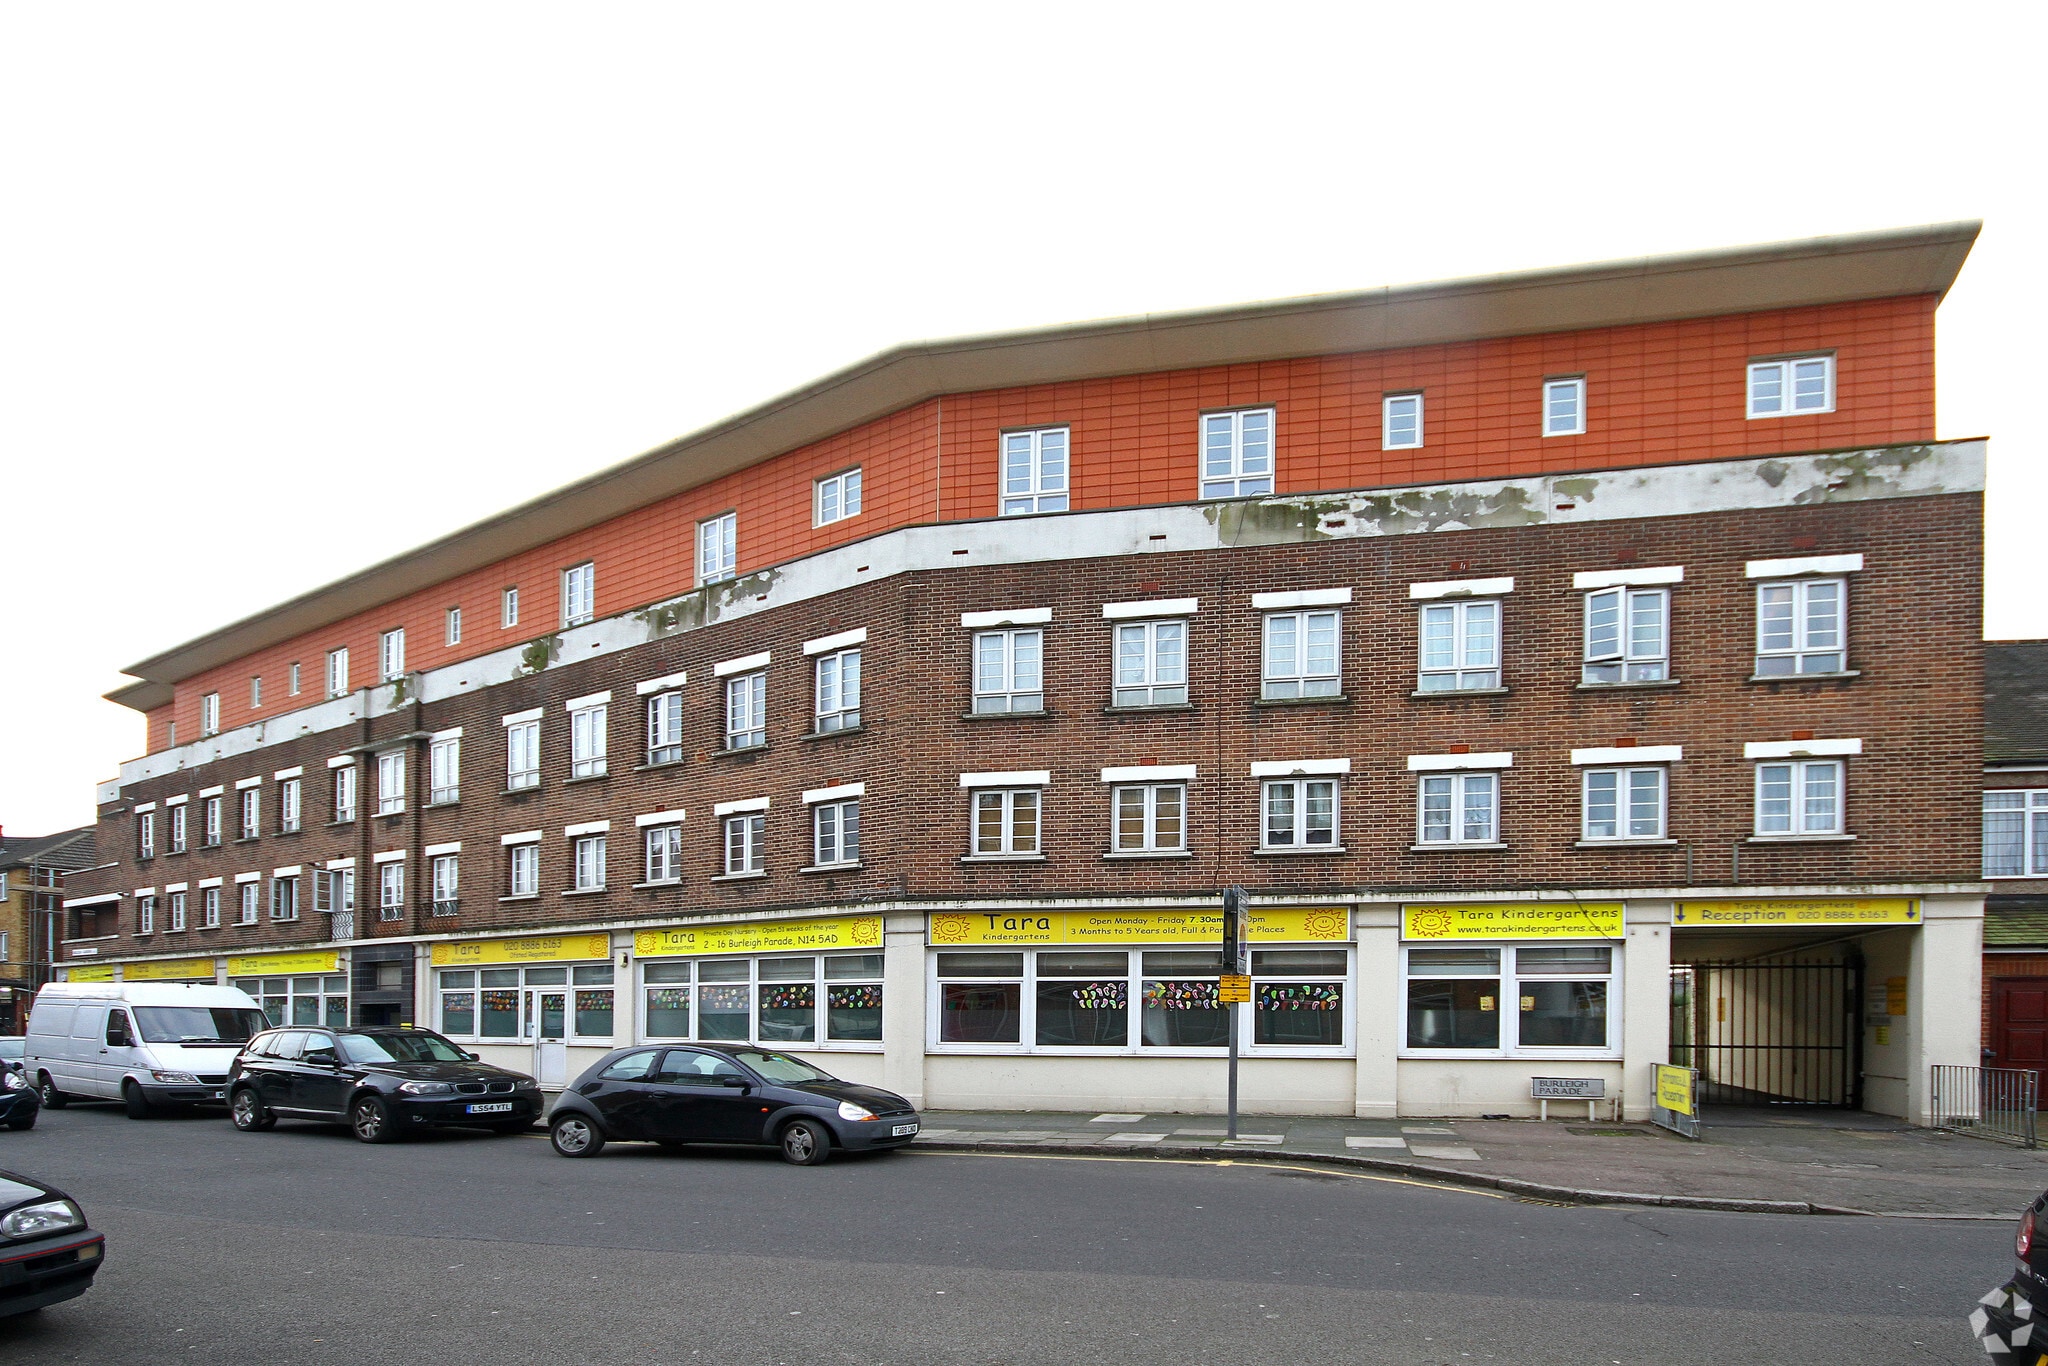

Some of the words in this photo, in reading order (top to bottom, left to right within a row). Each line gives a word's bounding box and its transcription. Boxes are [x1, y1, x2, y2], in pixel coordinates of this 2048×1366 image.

[1458, 910, 1493, 920] Tara
[1502, 910, 1618, 920] Kindergartens
[1702, 910, 1786, 922] Reception
[983, 914, 1050, 930] Tara
[1090, 918, 1111, 926] Open
[1458, 924, 1618, 934] www.tarakindergartens.co.uk
[662, 931, 695, 944] Tara
[729, 938, 761, 949] Burleigh
[764, 937, 796, 946] Parade,
[798, 936, 815, 944] N14
[818, 934, 838, 943] 5AD
[982, 933, 1050, 942] Kindergartens
[452, 943, 481, 955] Tara
[504, 942, 518, 951] 020
[520, 940, 540, 950] 8886
[543, 939, 562, 949] 6163
